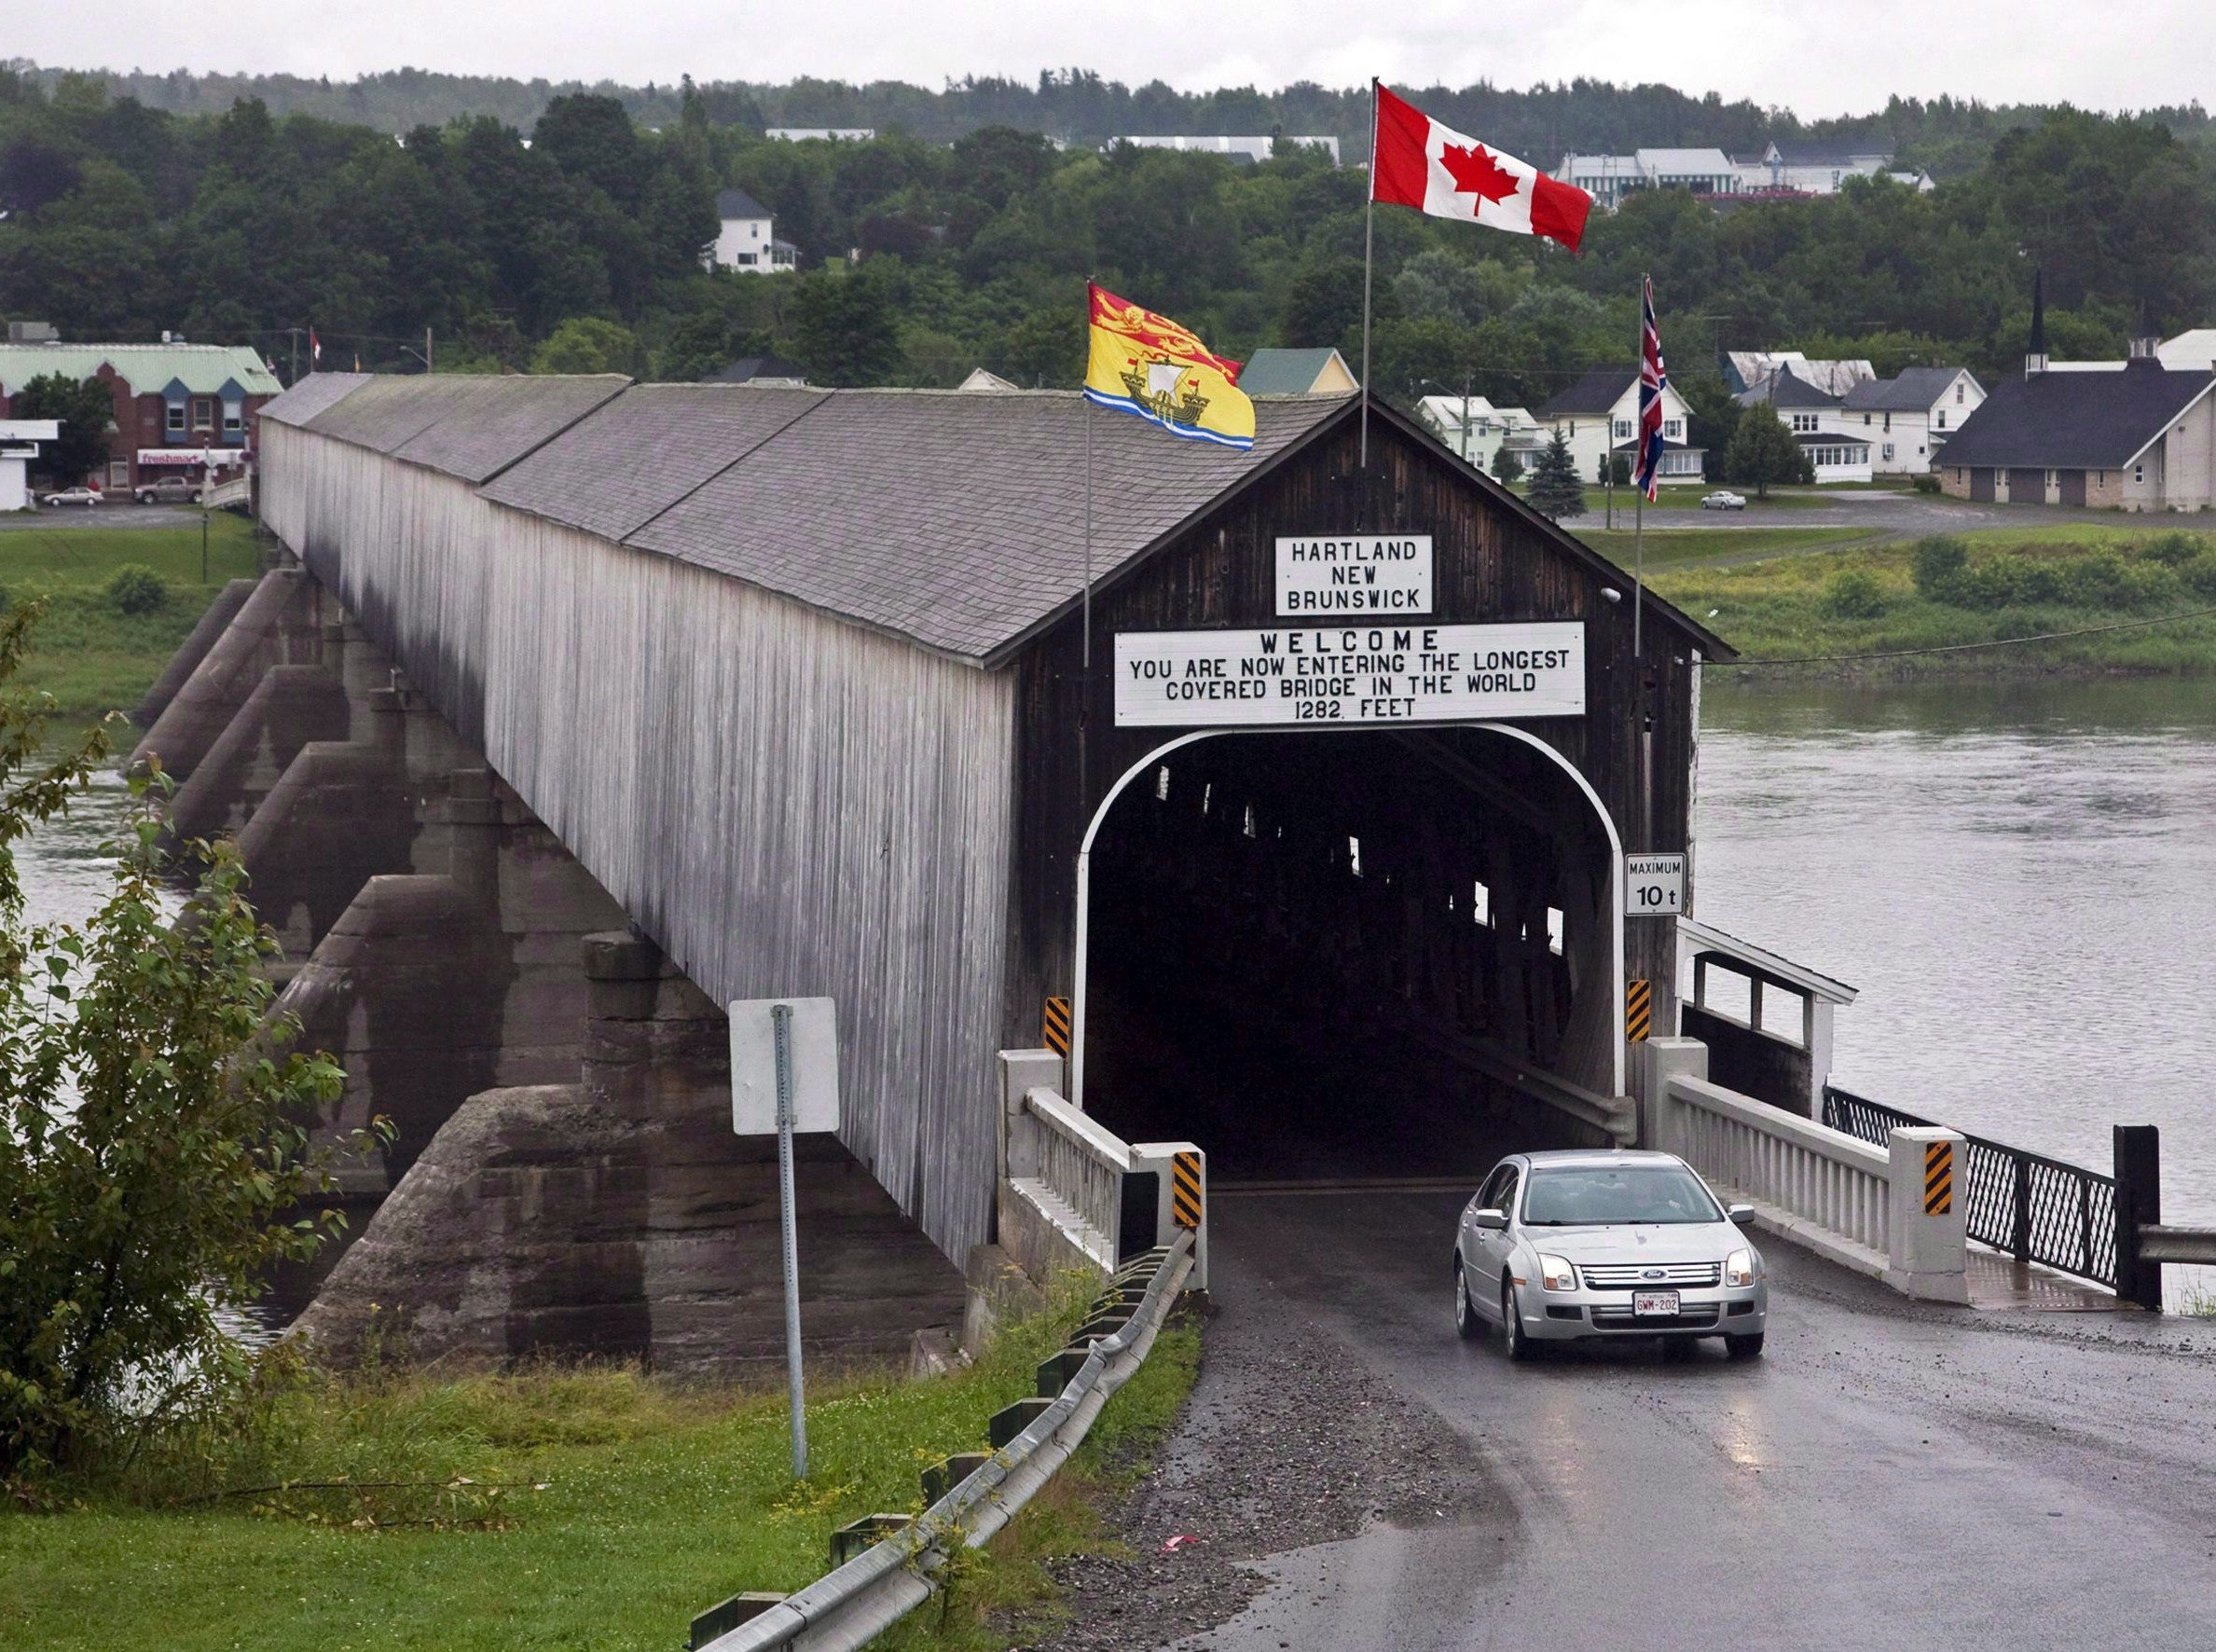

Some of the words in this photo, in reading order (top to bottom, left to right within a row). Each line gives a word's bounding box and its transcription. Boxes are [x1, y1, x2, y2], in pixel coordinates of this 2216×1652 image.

[143, 453, 199, 464] freshmart
[1292, 542, 1416, 561] HARTLAND
[1332, 566, 1376, 585] NEW
[1287, 589, 1420, 610] BRUNSWICK
[1260, 629, 1438, 654] WELCOME
[1130, 660, 1172, 679] YOU
[1186, 658, 1227, 678] ARE
[1241, 657, 1285, 677] NOW
[1297, 654, 1405, 675] ENTERING
[1419, 653, 1460, 671] THE
[1474, 650, 1570, 671] LONGEST
[1166, 680, 1266, 700] COVERED
[1281, 677, 1356, 698] BRIDGE
[1372, 677, 1392, 695] IN
[1408, 675, 1452, 695] THE
[1467, 673, 1535, 693] WORLD
[1295, 700, 1341, 720] 1282
[1361, 698, 1415, 717] FEET
[1630, 862, 1680, 874] MAXIMUM
[1637, 886, 1663, 906] 10
[1669, 889, 1676, 905] t
